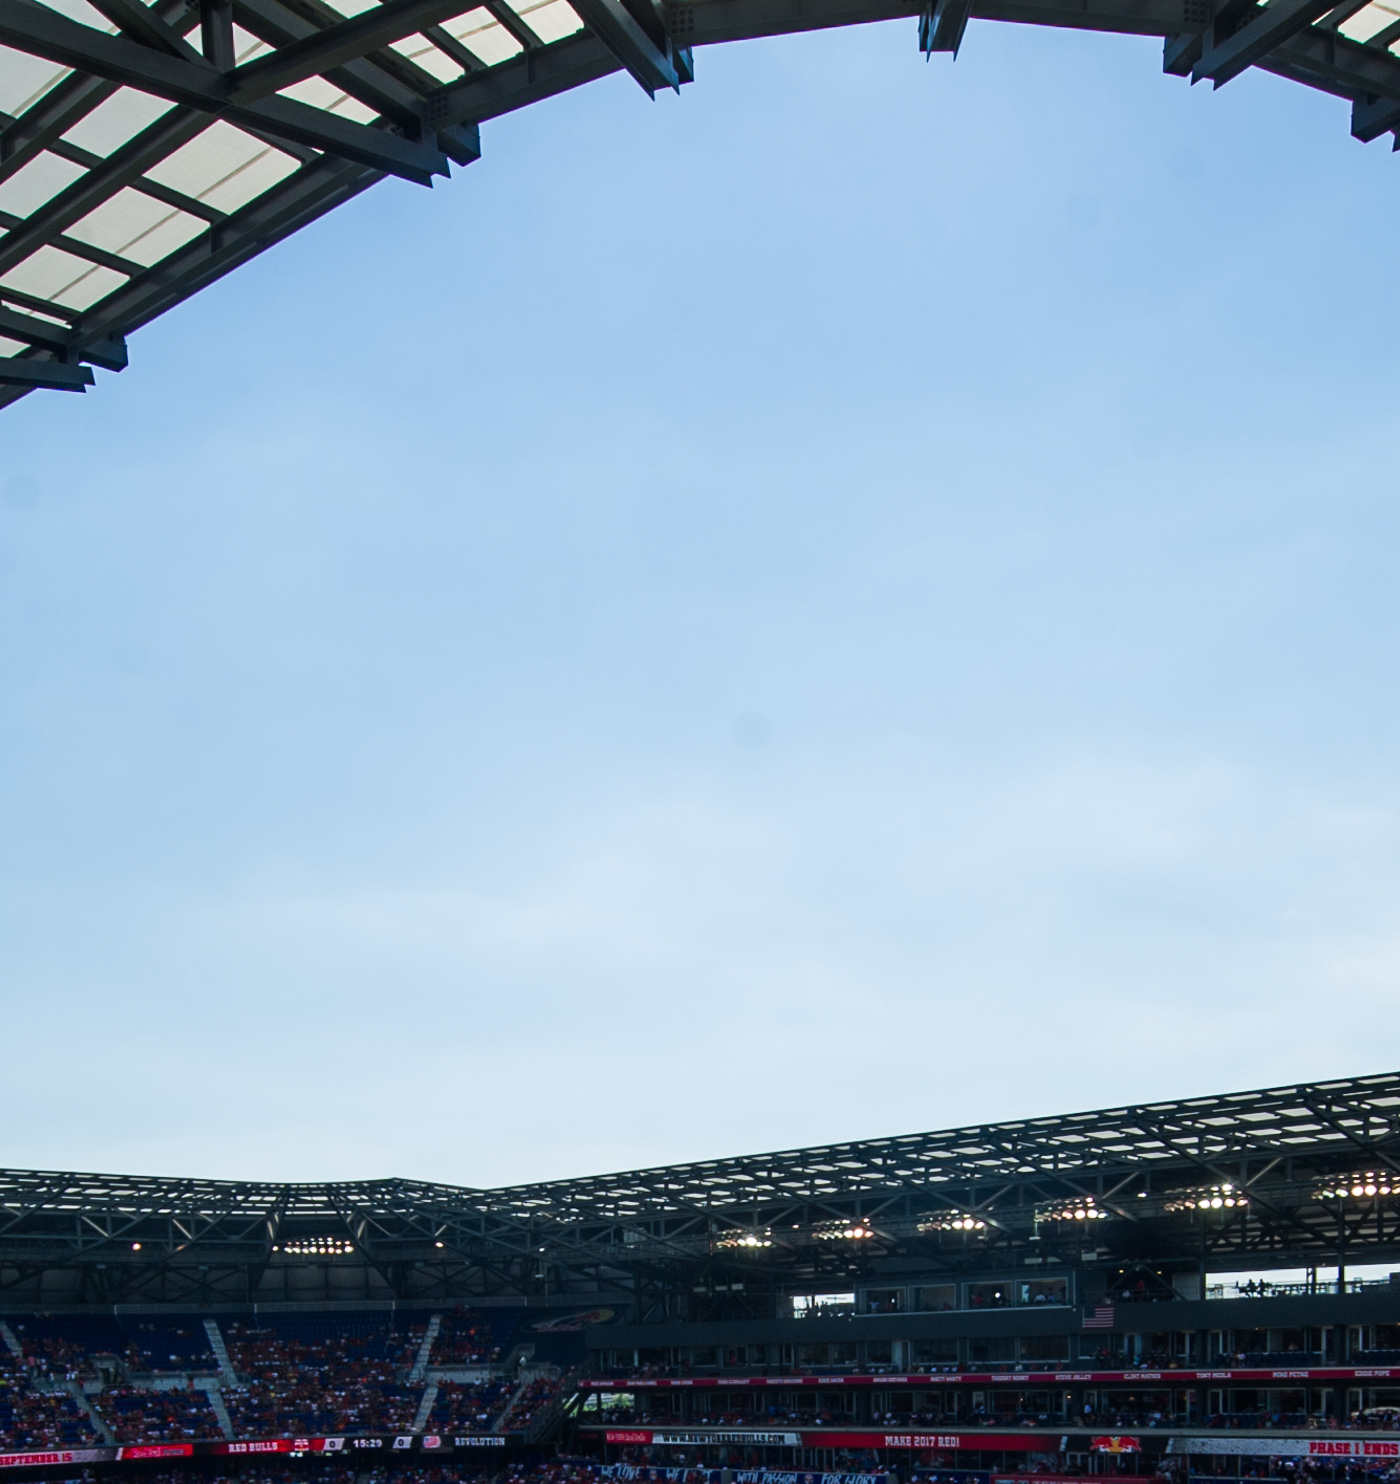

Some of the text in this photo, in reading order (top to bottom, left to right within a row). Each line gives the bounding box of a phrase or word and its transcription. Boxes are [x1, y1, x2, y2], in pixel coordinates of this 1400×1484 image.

[352, 1439, 382, 1448] 15:29
[454, 1437, 505, 1446] REVOLUTION
[885, 1436, 960, 1448] MAKE 2017 RED!
[1309, 1442, 1350, 1454] PHASE
[1363, 1443, 1399, 1455] ENDS
[737, 1472, 758, 1484] WITH
